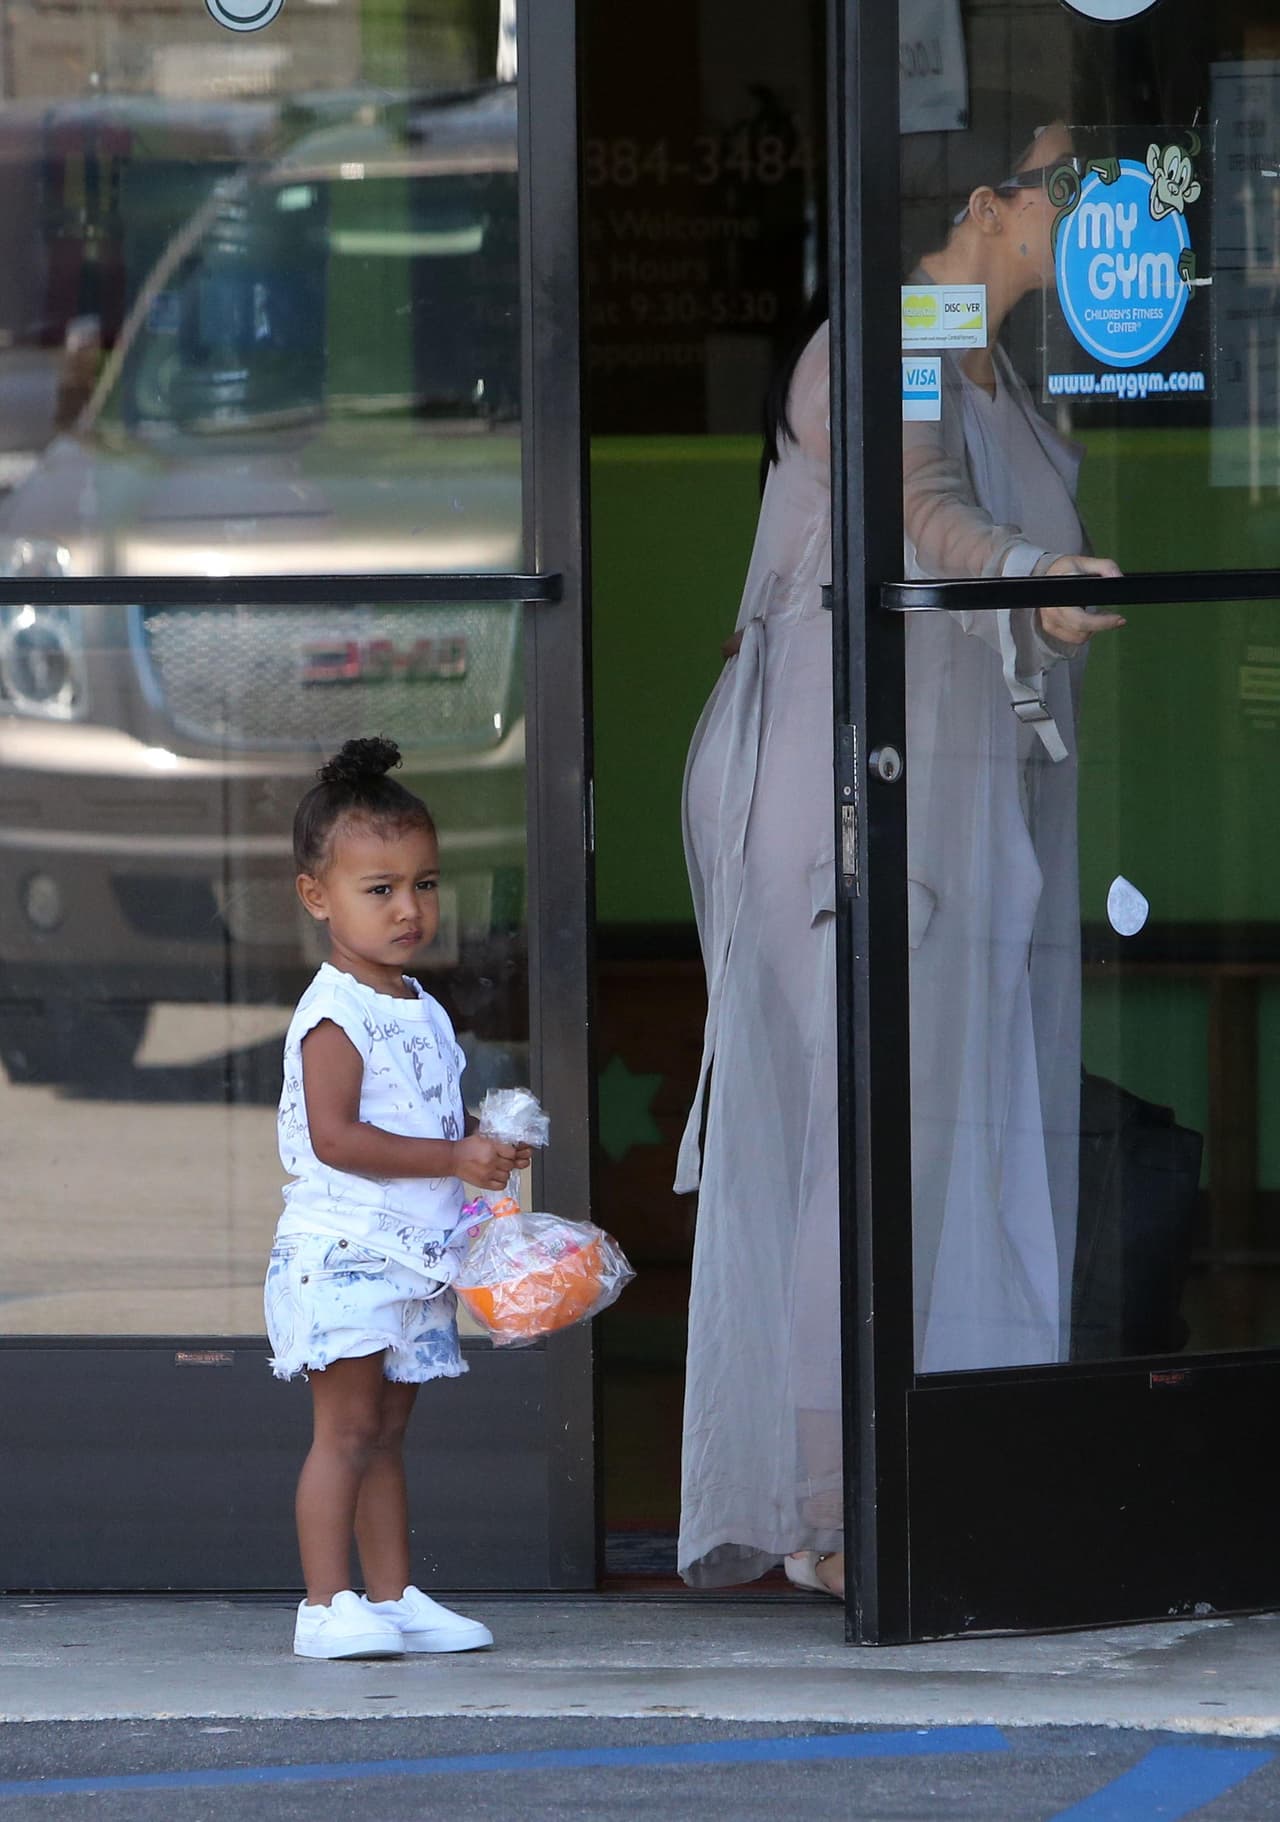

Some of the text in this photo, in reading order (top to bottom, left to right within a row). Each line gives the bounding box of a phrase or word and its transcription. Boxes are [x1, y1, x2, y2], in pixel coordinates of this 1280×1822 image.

[1132, 308, 1164, 320] FITNESS
[907, 369, 937, 386] VISA
[1048, 371, 1205, 398] www.mygym.com
